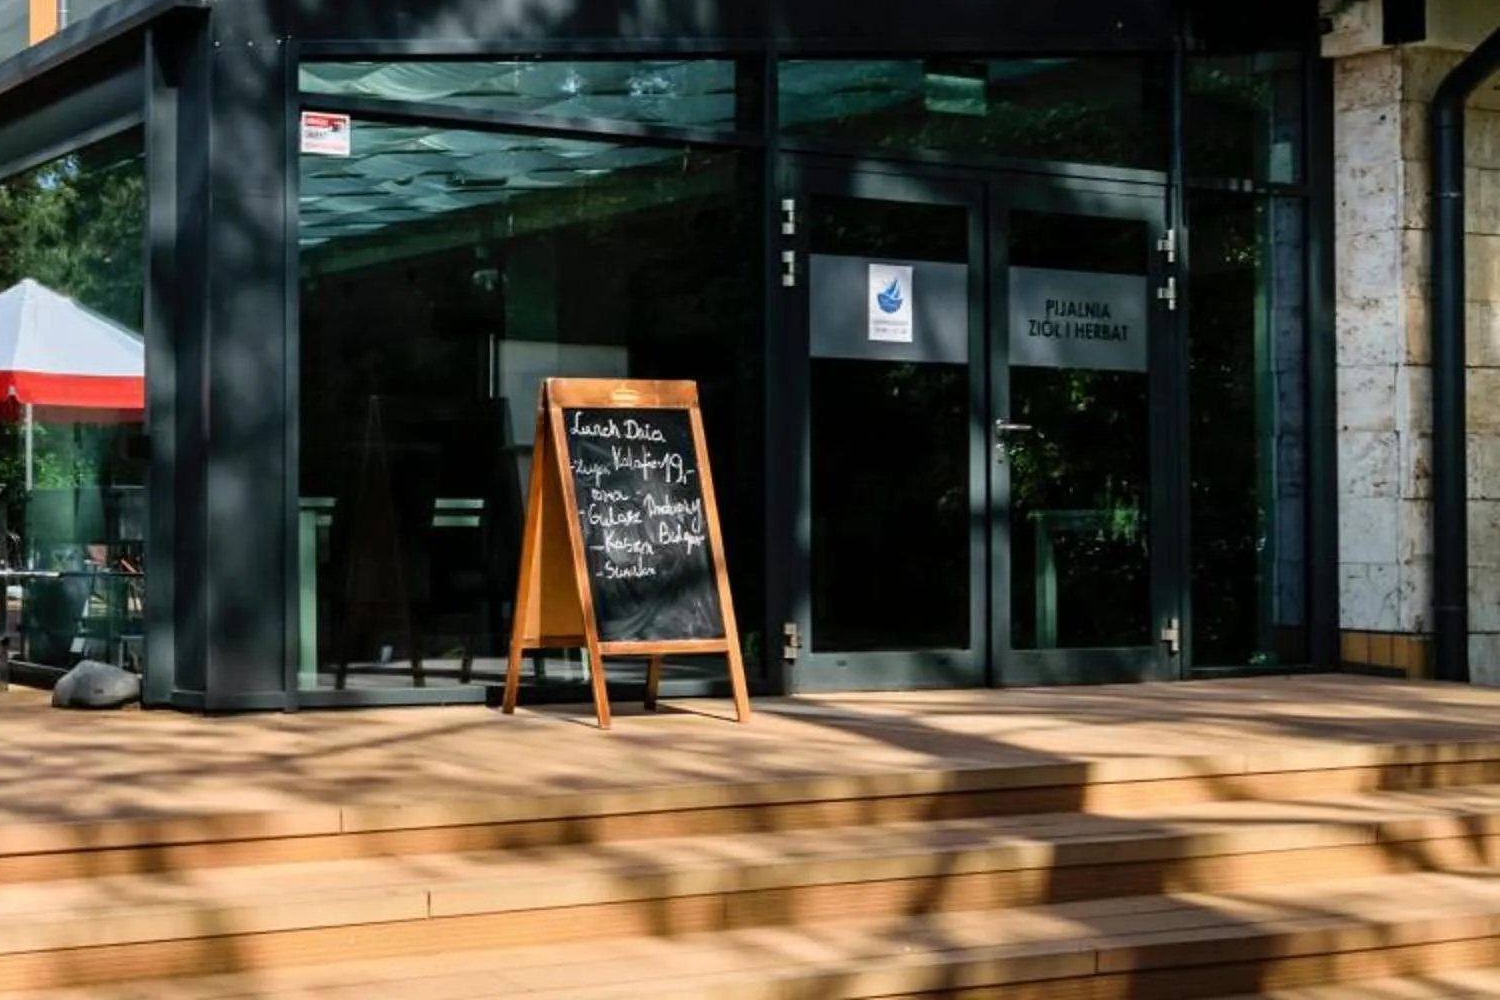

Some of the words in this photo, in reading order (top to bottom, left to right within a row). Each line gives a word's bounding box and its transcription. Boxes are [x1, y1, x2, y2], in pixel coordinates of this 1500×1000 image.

[1045, 299, 1112, 319] PIJALNIA
[1075, 323, 1129, 342] HERBAT
[570, 411, 621, 439] Lunch
